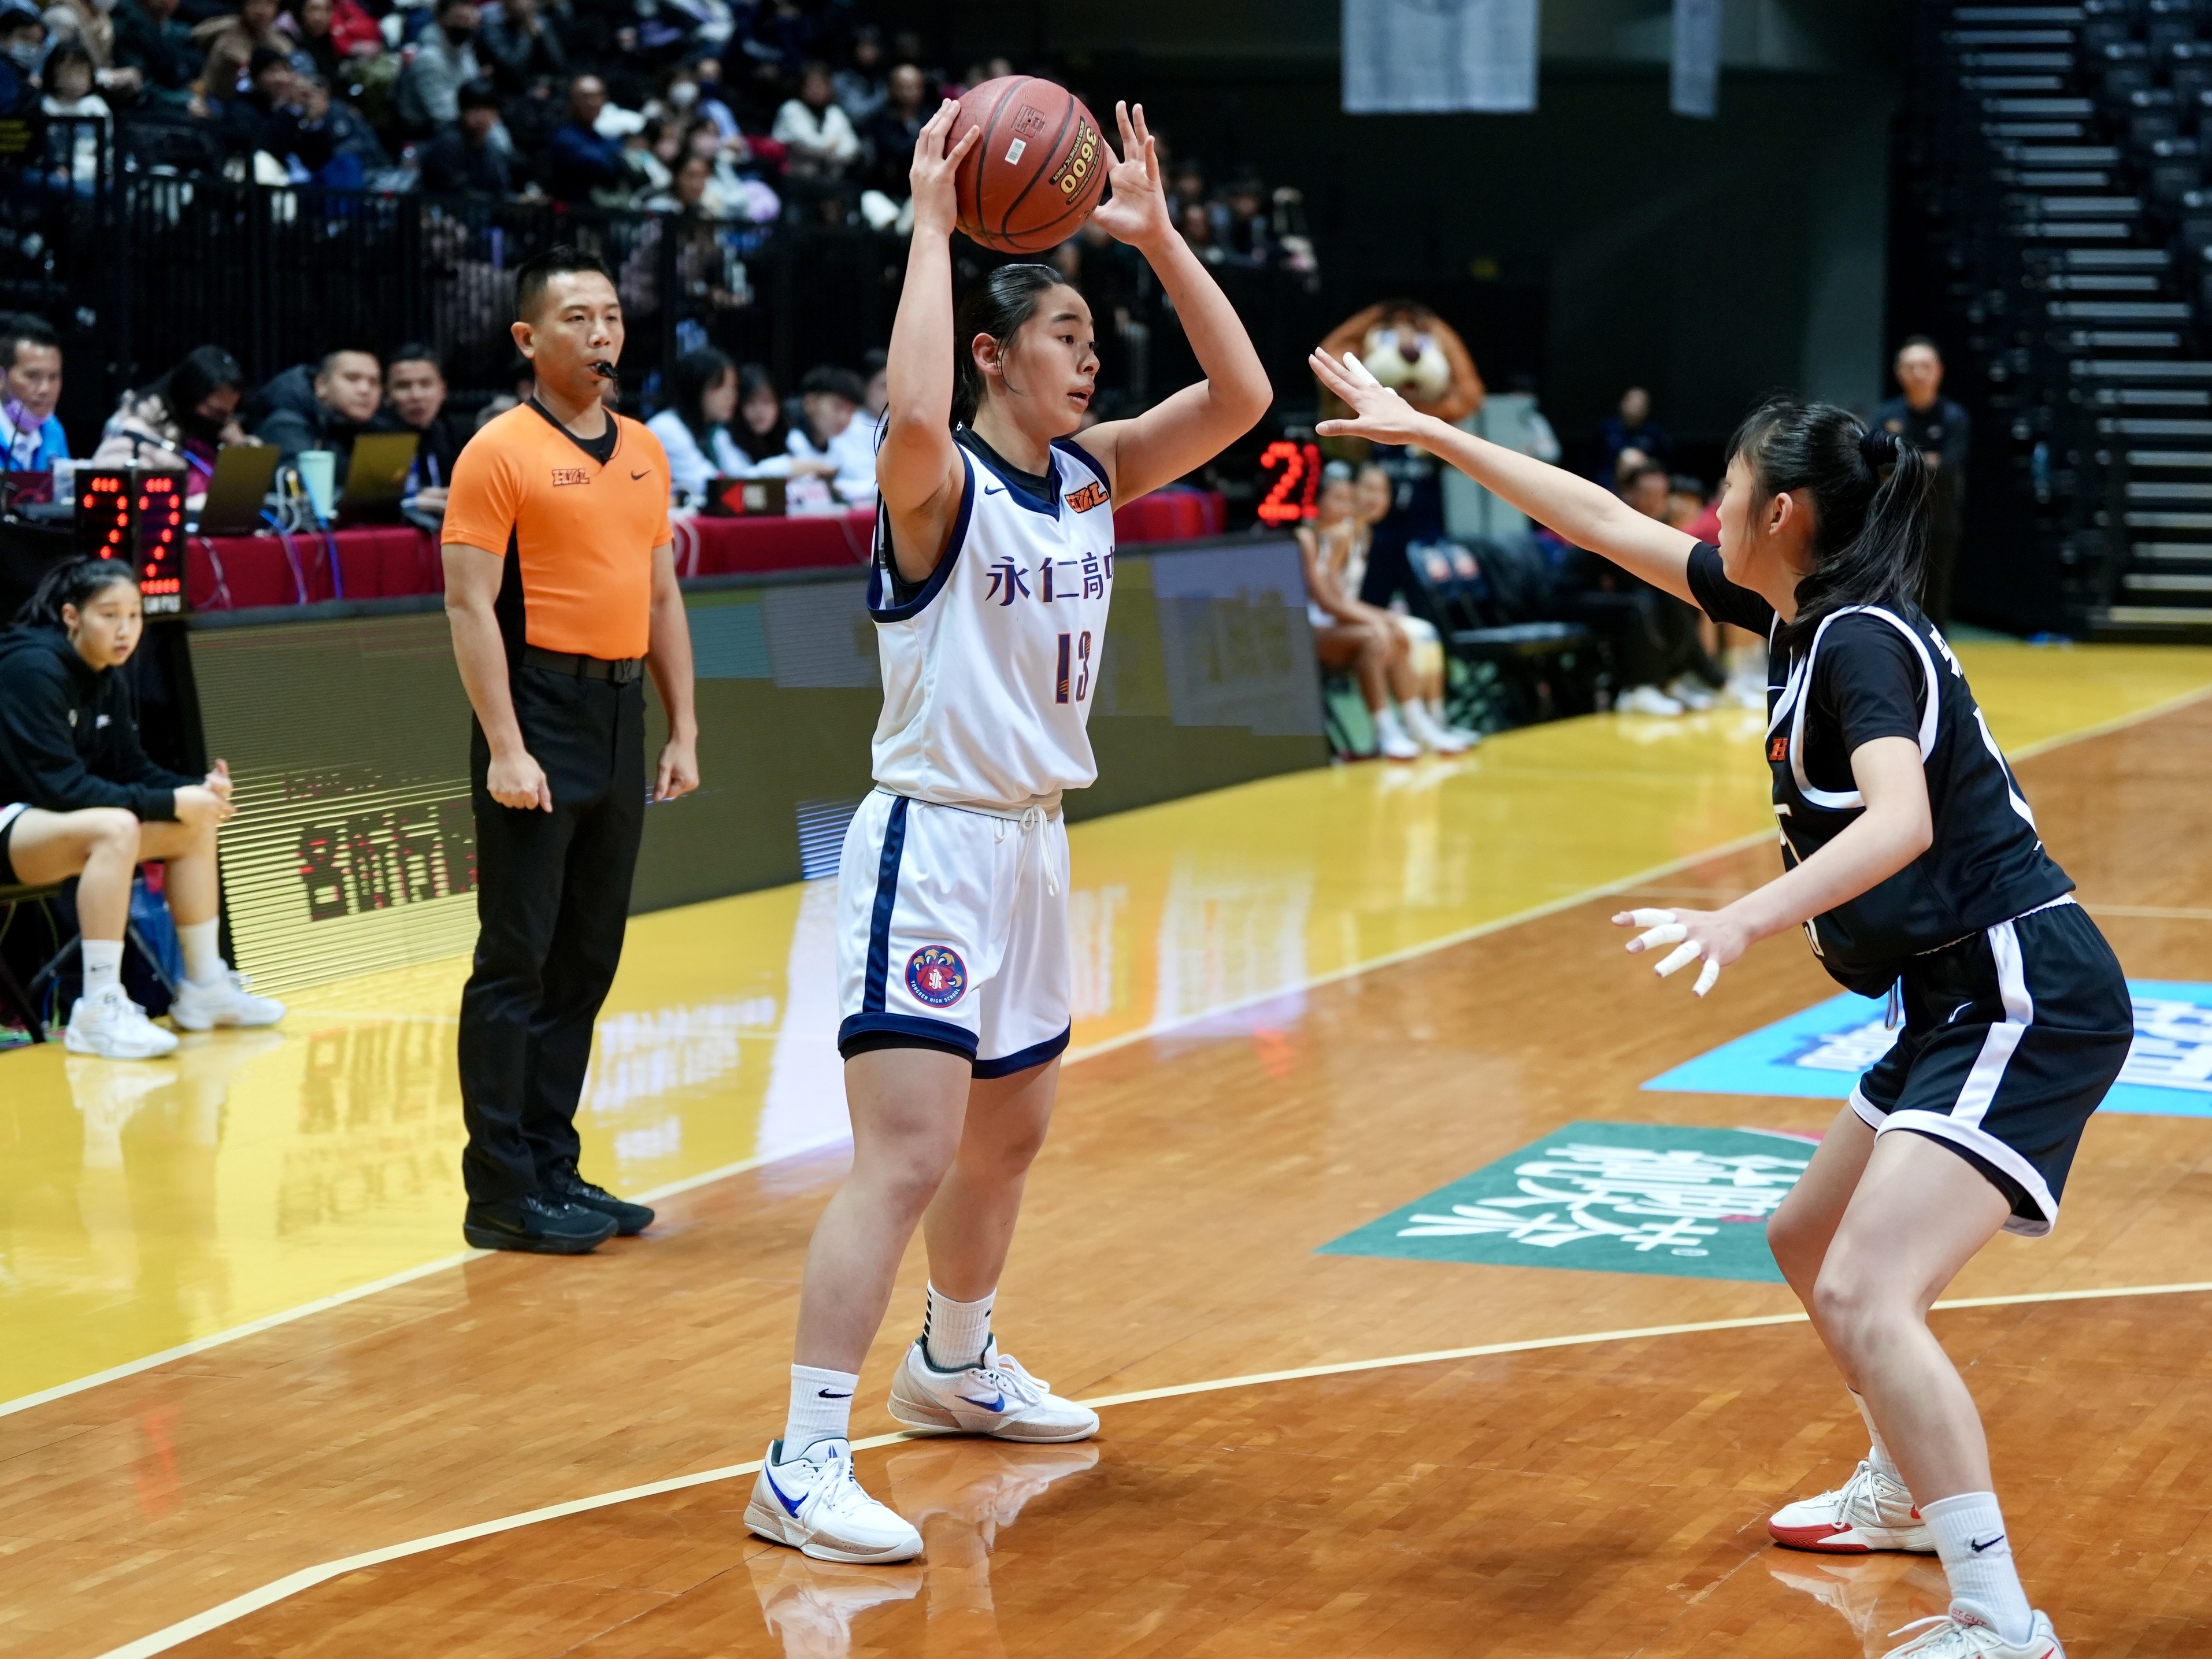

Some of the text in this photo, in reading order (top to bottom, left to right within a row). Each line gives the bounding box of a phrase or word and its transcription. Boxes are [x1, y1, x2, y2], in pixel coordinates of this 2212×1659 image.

[1060, 126, 1097, 194] 3600
[1066, 136, 1082, 166] SYNTHETIC
[1053, 164, 1067, 182] FIBER
[1055, 630, 1092, 705] 13
[910, 980, 928, 1001] YONGREN
[944, 988, 961, 1003] SCHOOL
[1965, 1613, 1987, 1626] CUT
